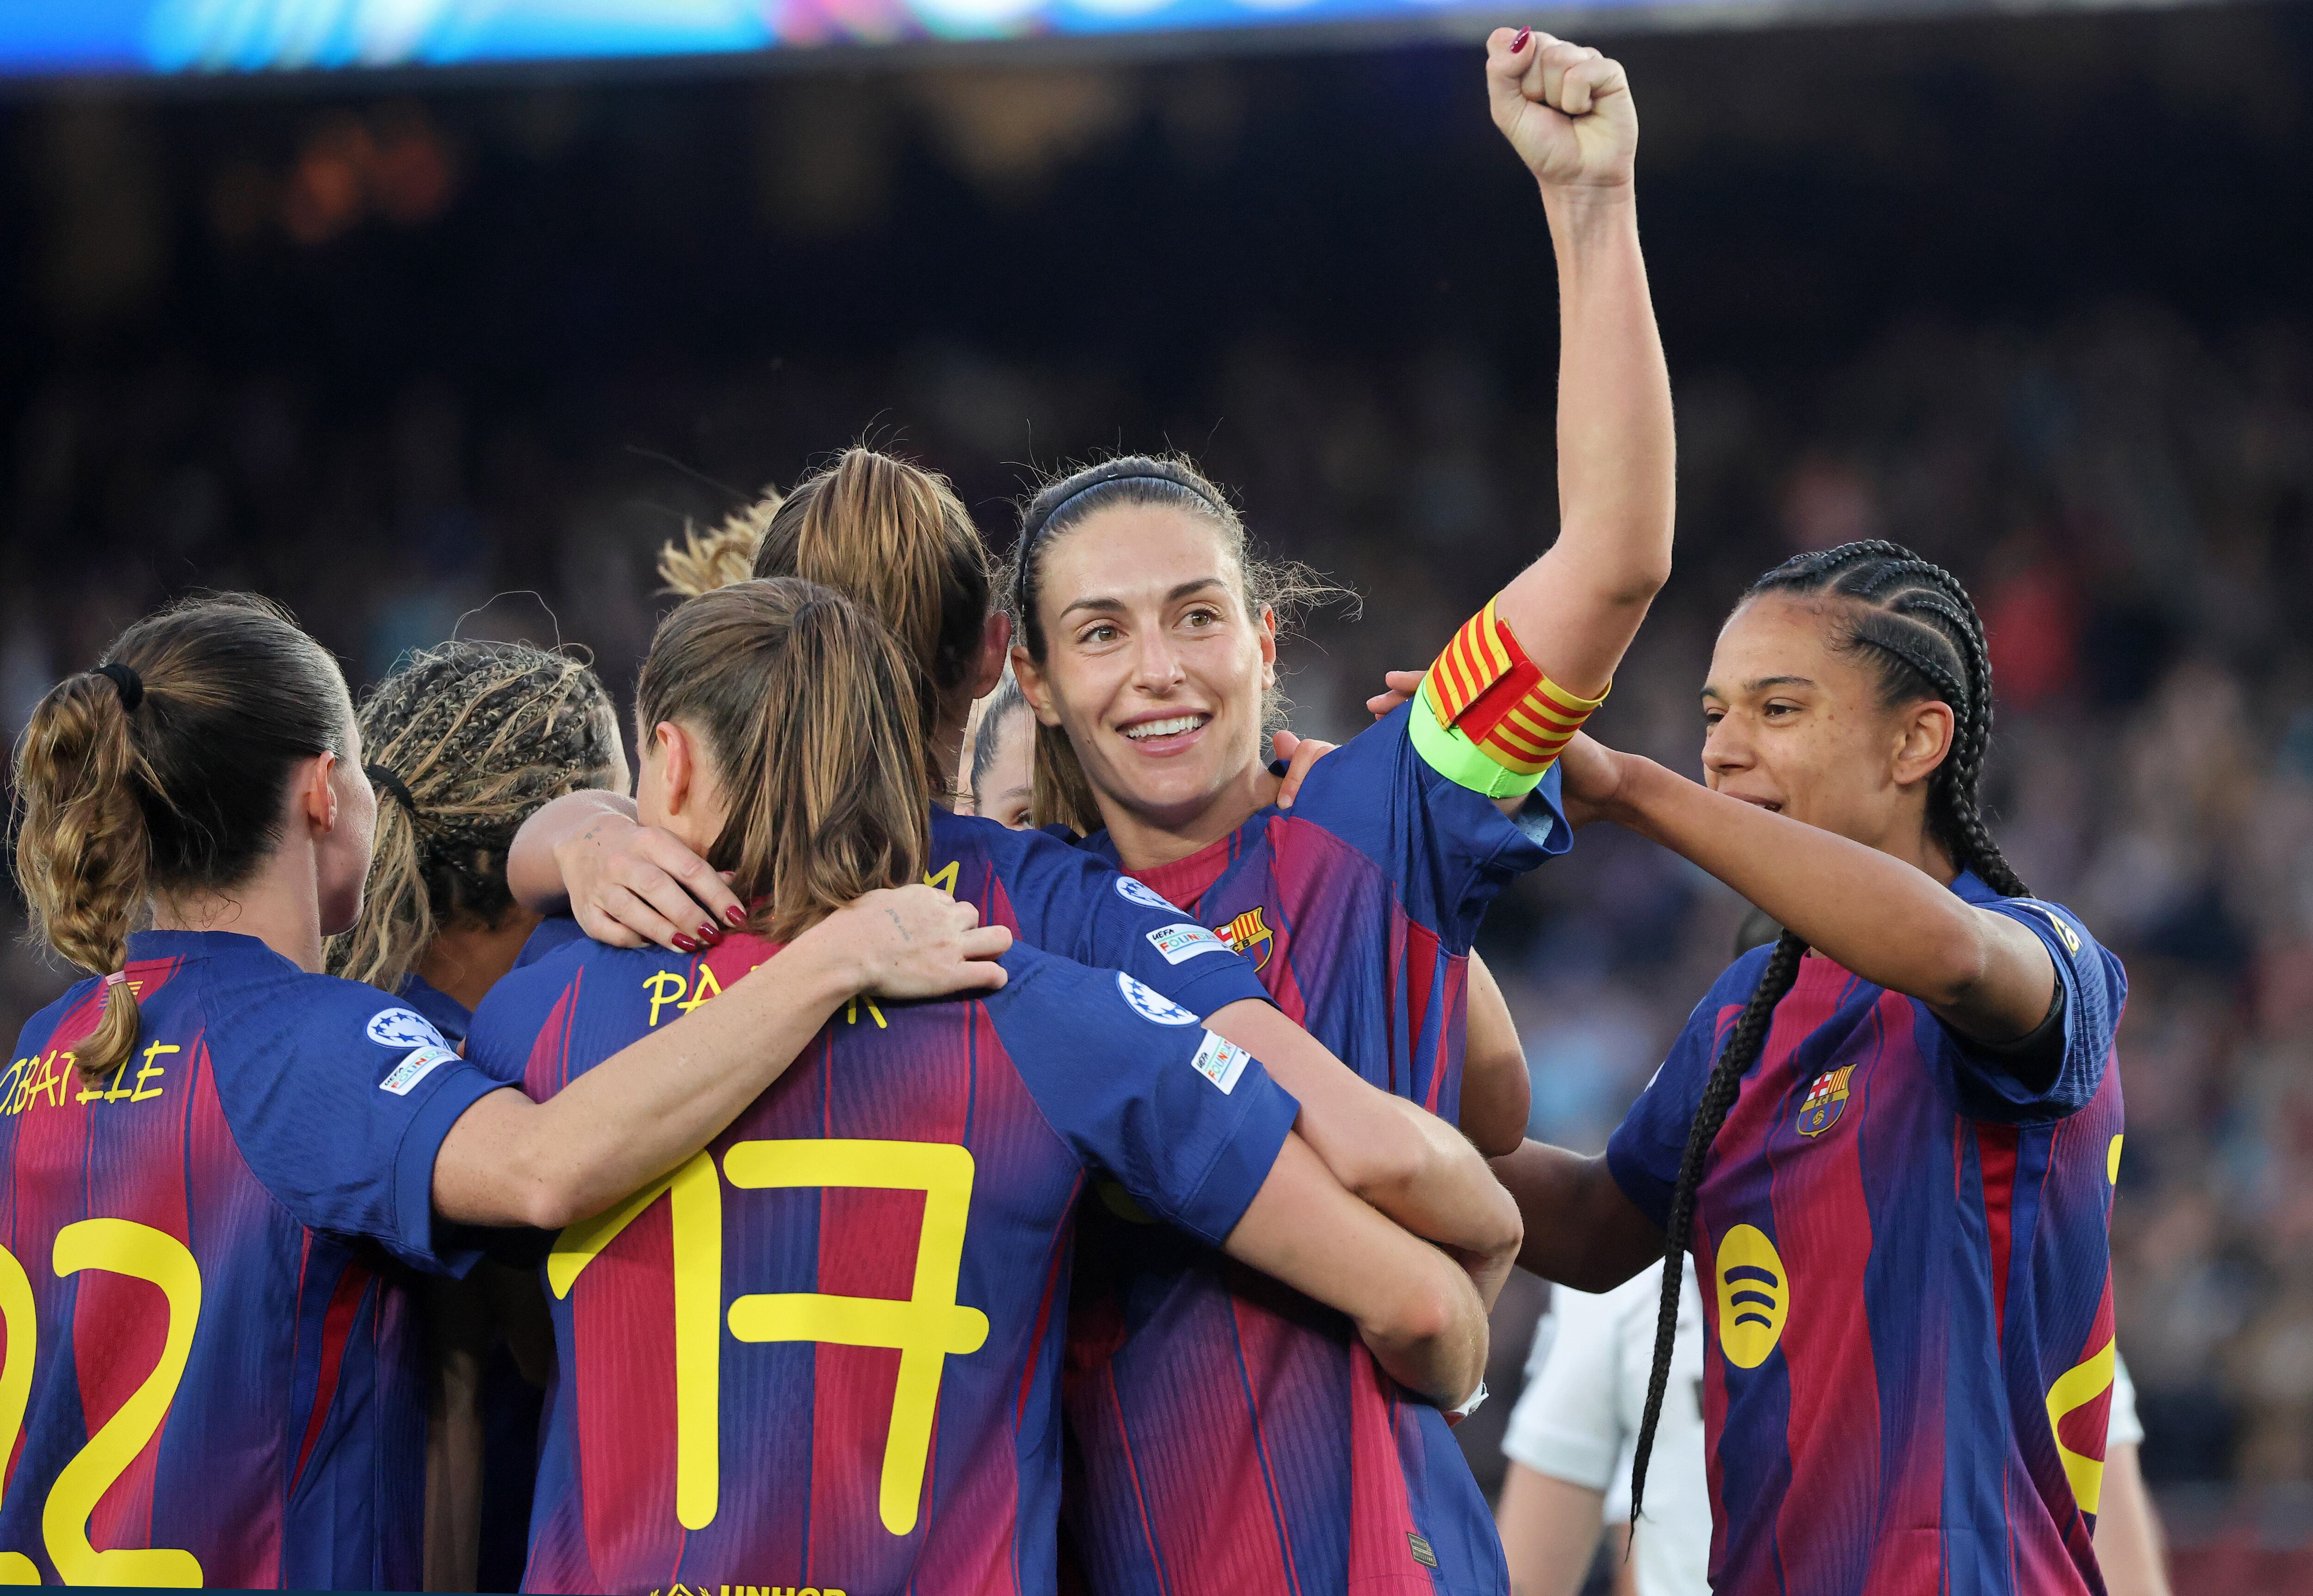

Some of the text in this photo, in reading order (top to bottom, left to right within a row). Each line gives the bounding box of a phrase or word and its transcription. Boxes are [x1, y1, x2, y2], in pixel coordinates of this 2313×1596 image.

[1152, 928, 1175, 940] UEFA
[1196, 1052, 1209, 1069] UEFA
[384, 1066, 404, 1086] UEFA
[547, 1138, 990, 1536] 17
